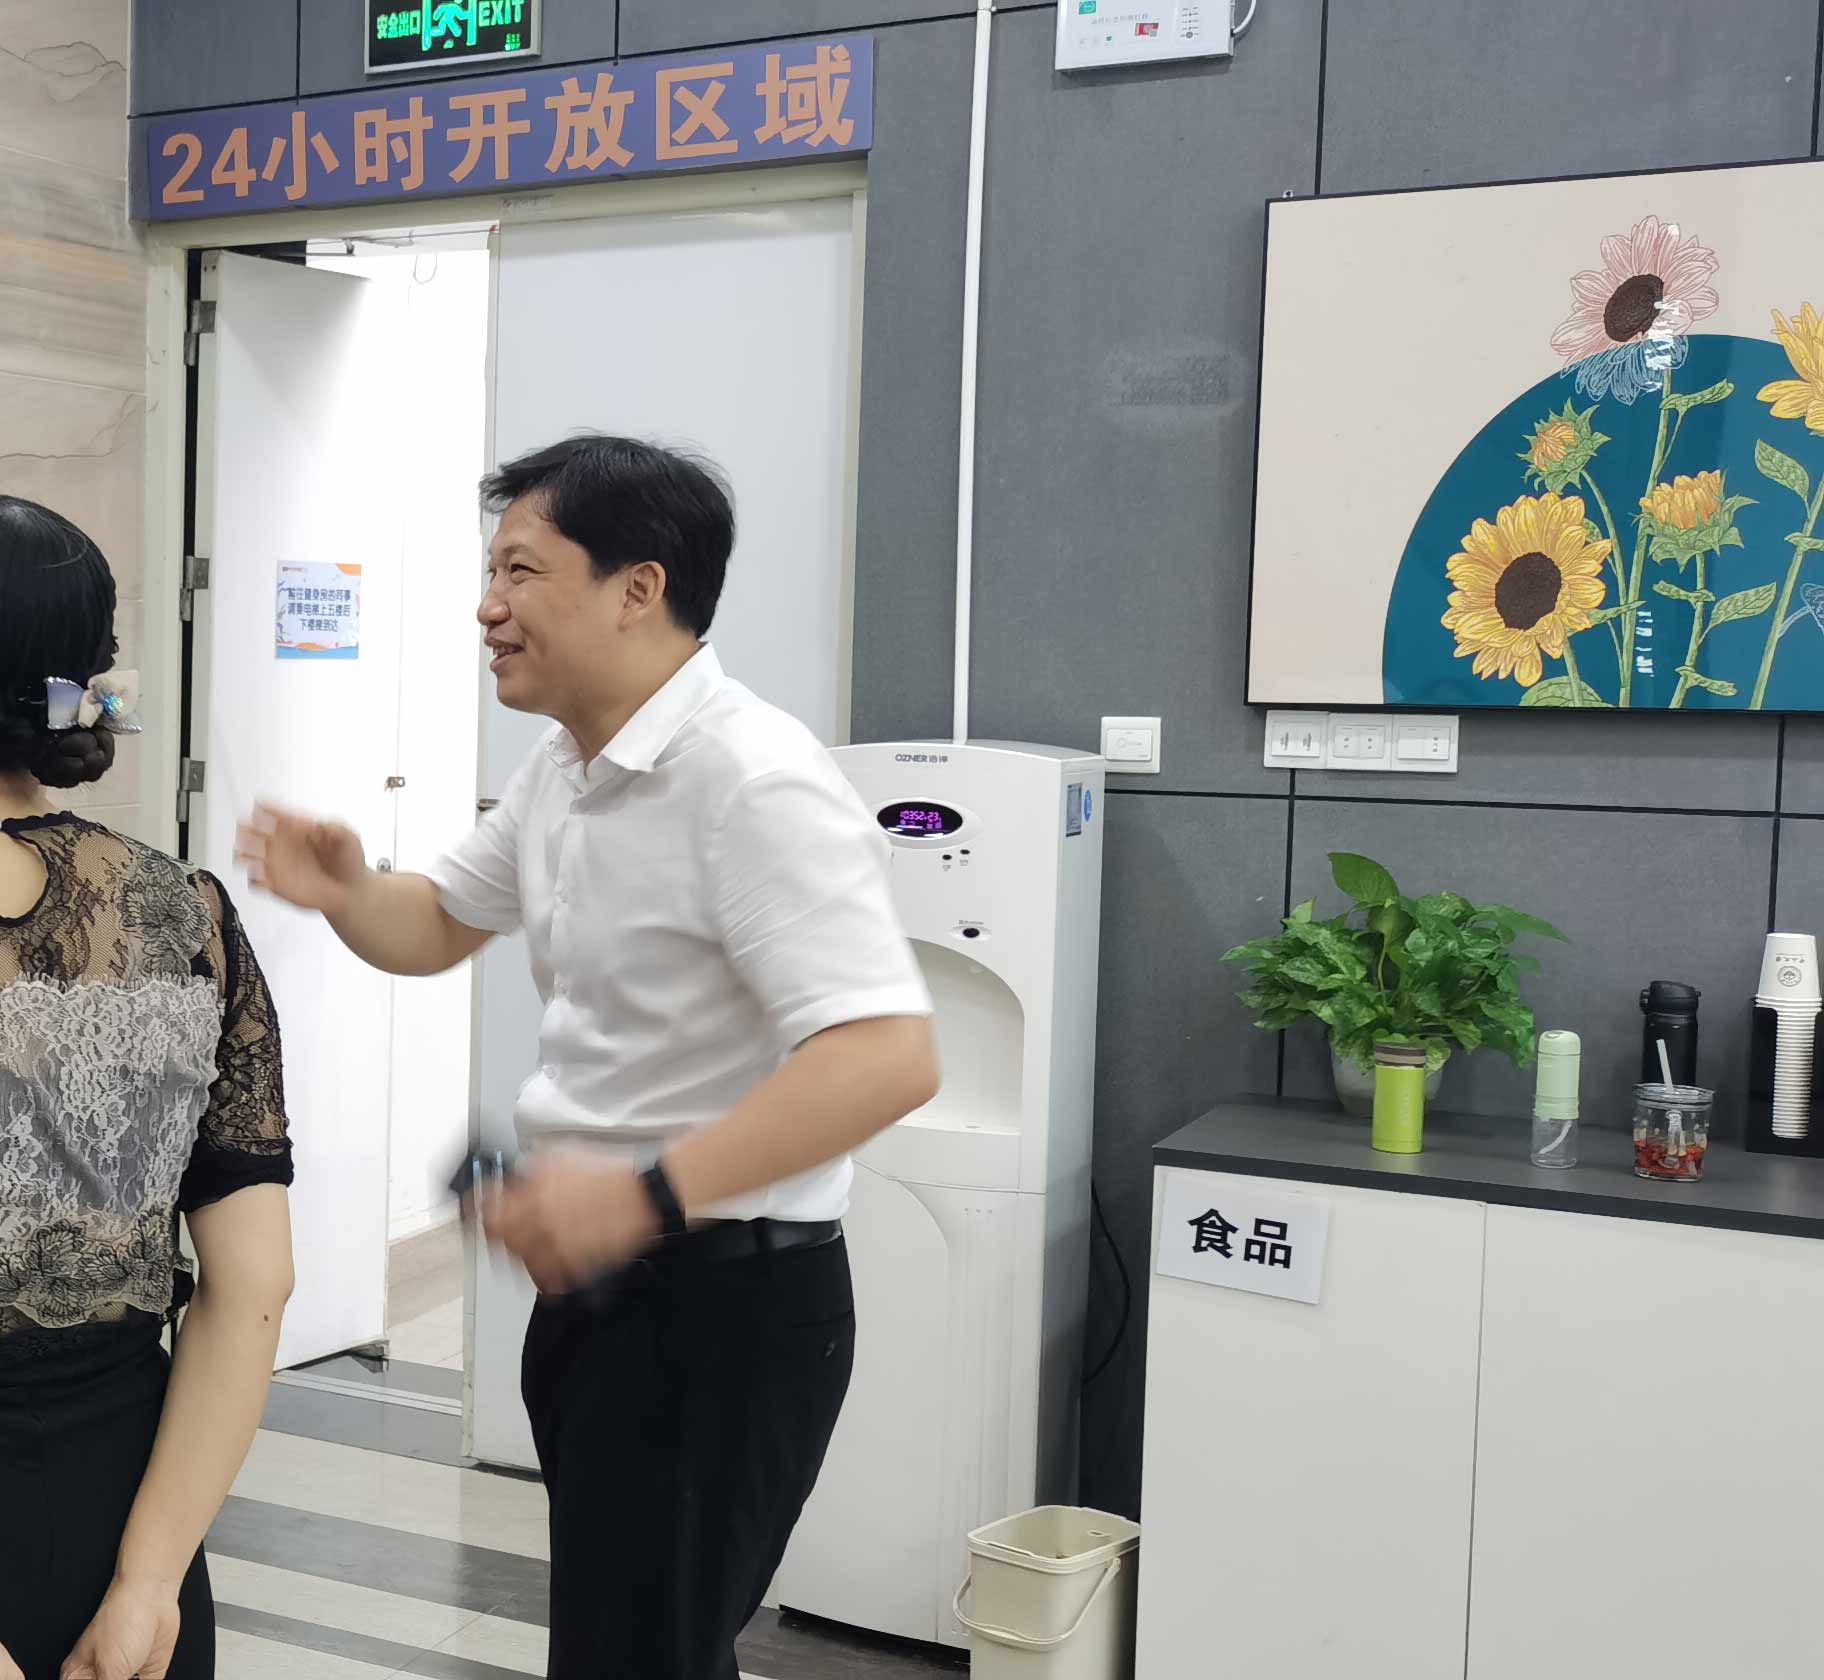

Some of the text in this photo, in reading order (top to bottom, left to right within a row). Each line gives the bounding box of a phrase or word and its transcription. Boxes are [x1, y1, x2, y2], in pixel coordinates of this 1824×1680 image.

[377, 10, 421, 39] 安全出口
[478, 0, 524, 27] EXIT
[162, 44, 852, 205] 24小时开放区域
[1188, 1208, 1293, 1269] 食品
